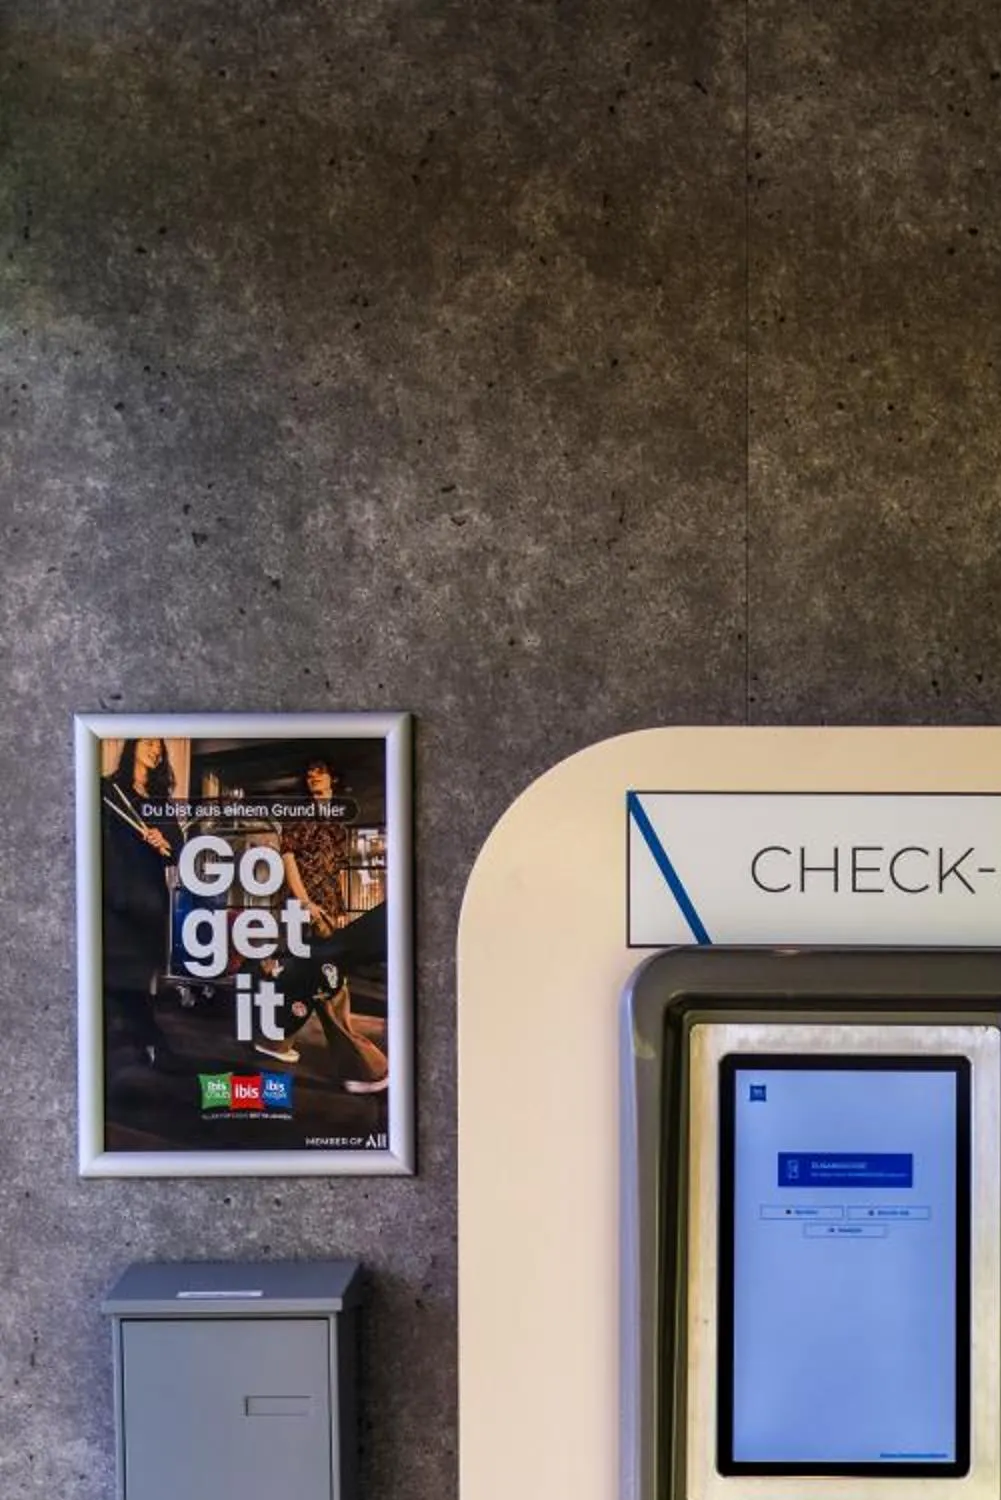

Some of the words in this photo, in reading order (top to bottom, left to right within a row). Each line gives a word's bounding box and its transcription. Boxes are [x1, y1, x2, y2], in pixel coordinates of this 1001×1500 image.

[142, 803, 163, 818] Du
[165, 803, 192, 818] bist
[195, 806, 221, 818] aus
[223, 803, 269, 818] einem
[271, 803, 315, 818] Grund
[318, 803, 345, 818] hier
[179, 835, 285, 897] Go
[182, 898, 311, 978] get
[236, 973, 285, 1041] it
[235, 1084, 259, 1099] ibis
